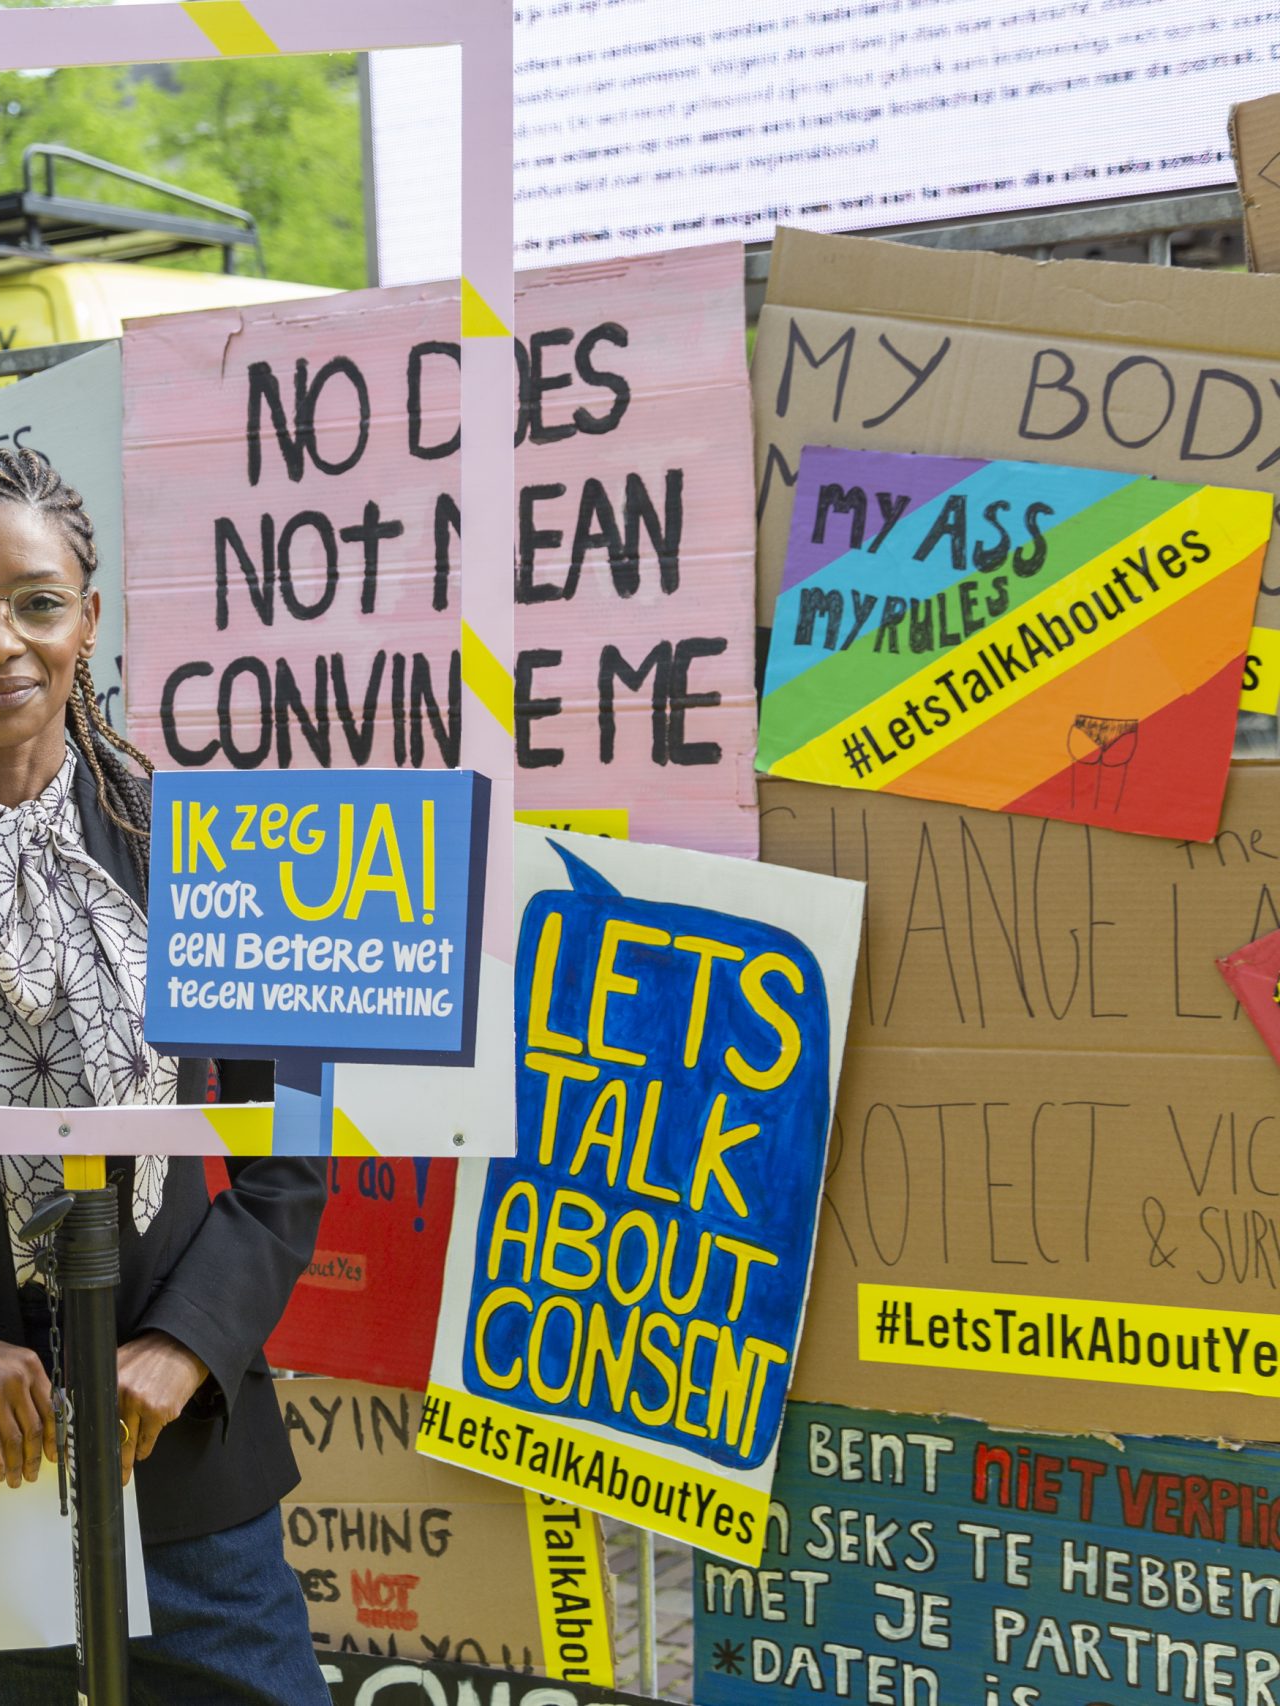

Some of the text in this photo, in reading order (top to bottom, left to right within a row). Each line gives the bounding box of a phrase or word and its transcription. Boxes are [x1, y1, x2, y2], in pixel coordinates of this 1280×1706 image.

[247, 357, 370, 487] NO
[776, 317, 951, 428] MY
[811, 482, 911, 554] MY
[912, 494, 1056, 578] ASS
[161, 648, 565, 769] CONVINE
[598, 637, 728, 767] ME
[842, 529, 1213, 779] #LetsTalkAboutYes
[172, 800, 227, 874] IK
[279, 799, 436, 926] JA!
[524, 910, 806, 1093] LETS
[524, 1050, 761, 1219] TALK
[487, 1179, 779, 1323] ABOUT
[474, 1286, 789, 1461] CONSENT
[419, 1396, 757, 1546] #LetsTalkAboutYes
[350, 1568, 421, 1611] NOT
[805, 1504, 937, 1573] SEKS
[957, 1521, 1032, 1588] TE
[874, 1582, 952, 1650] JE
